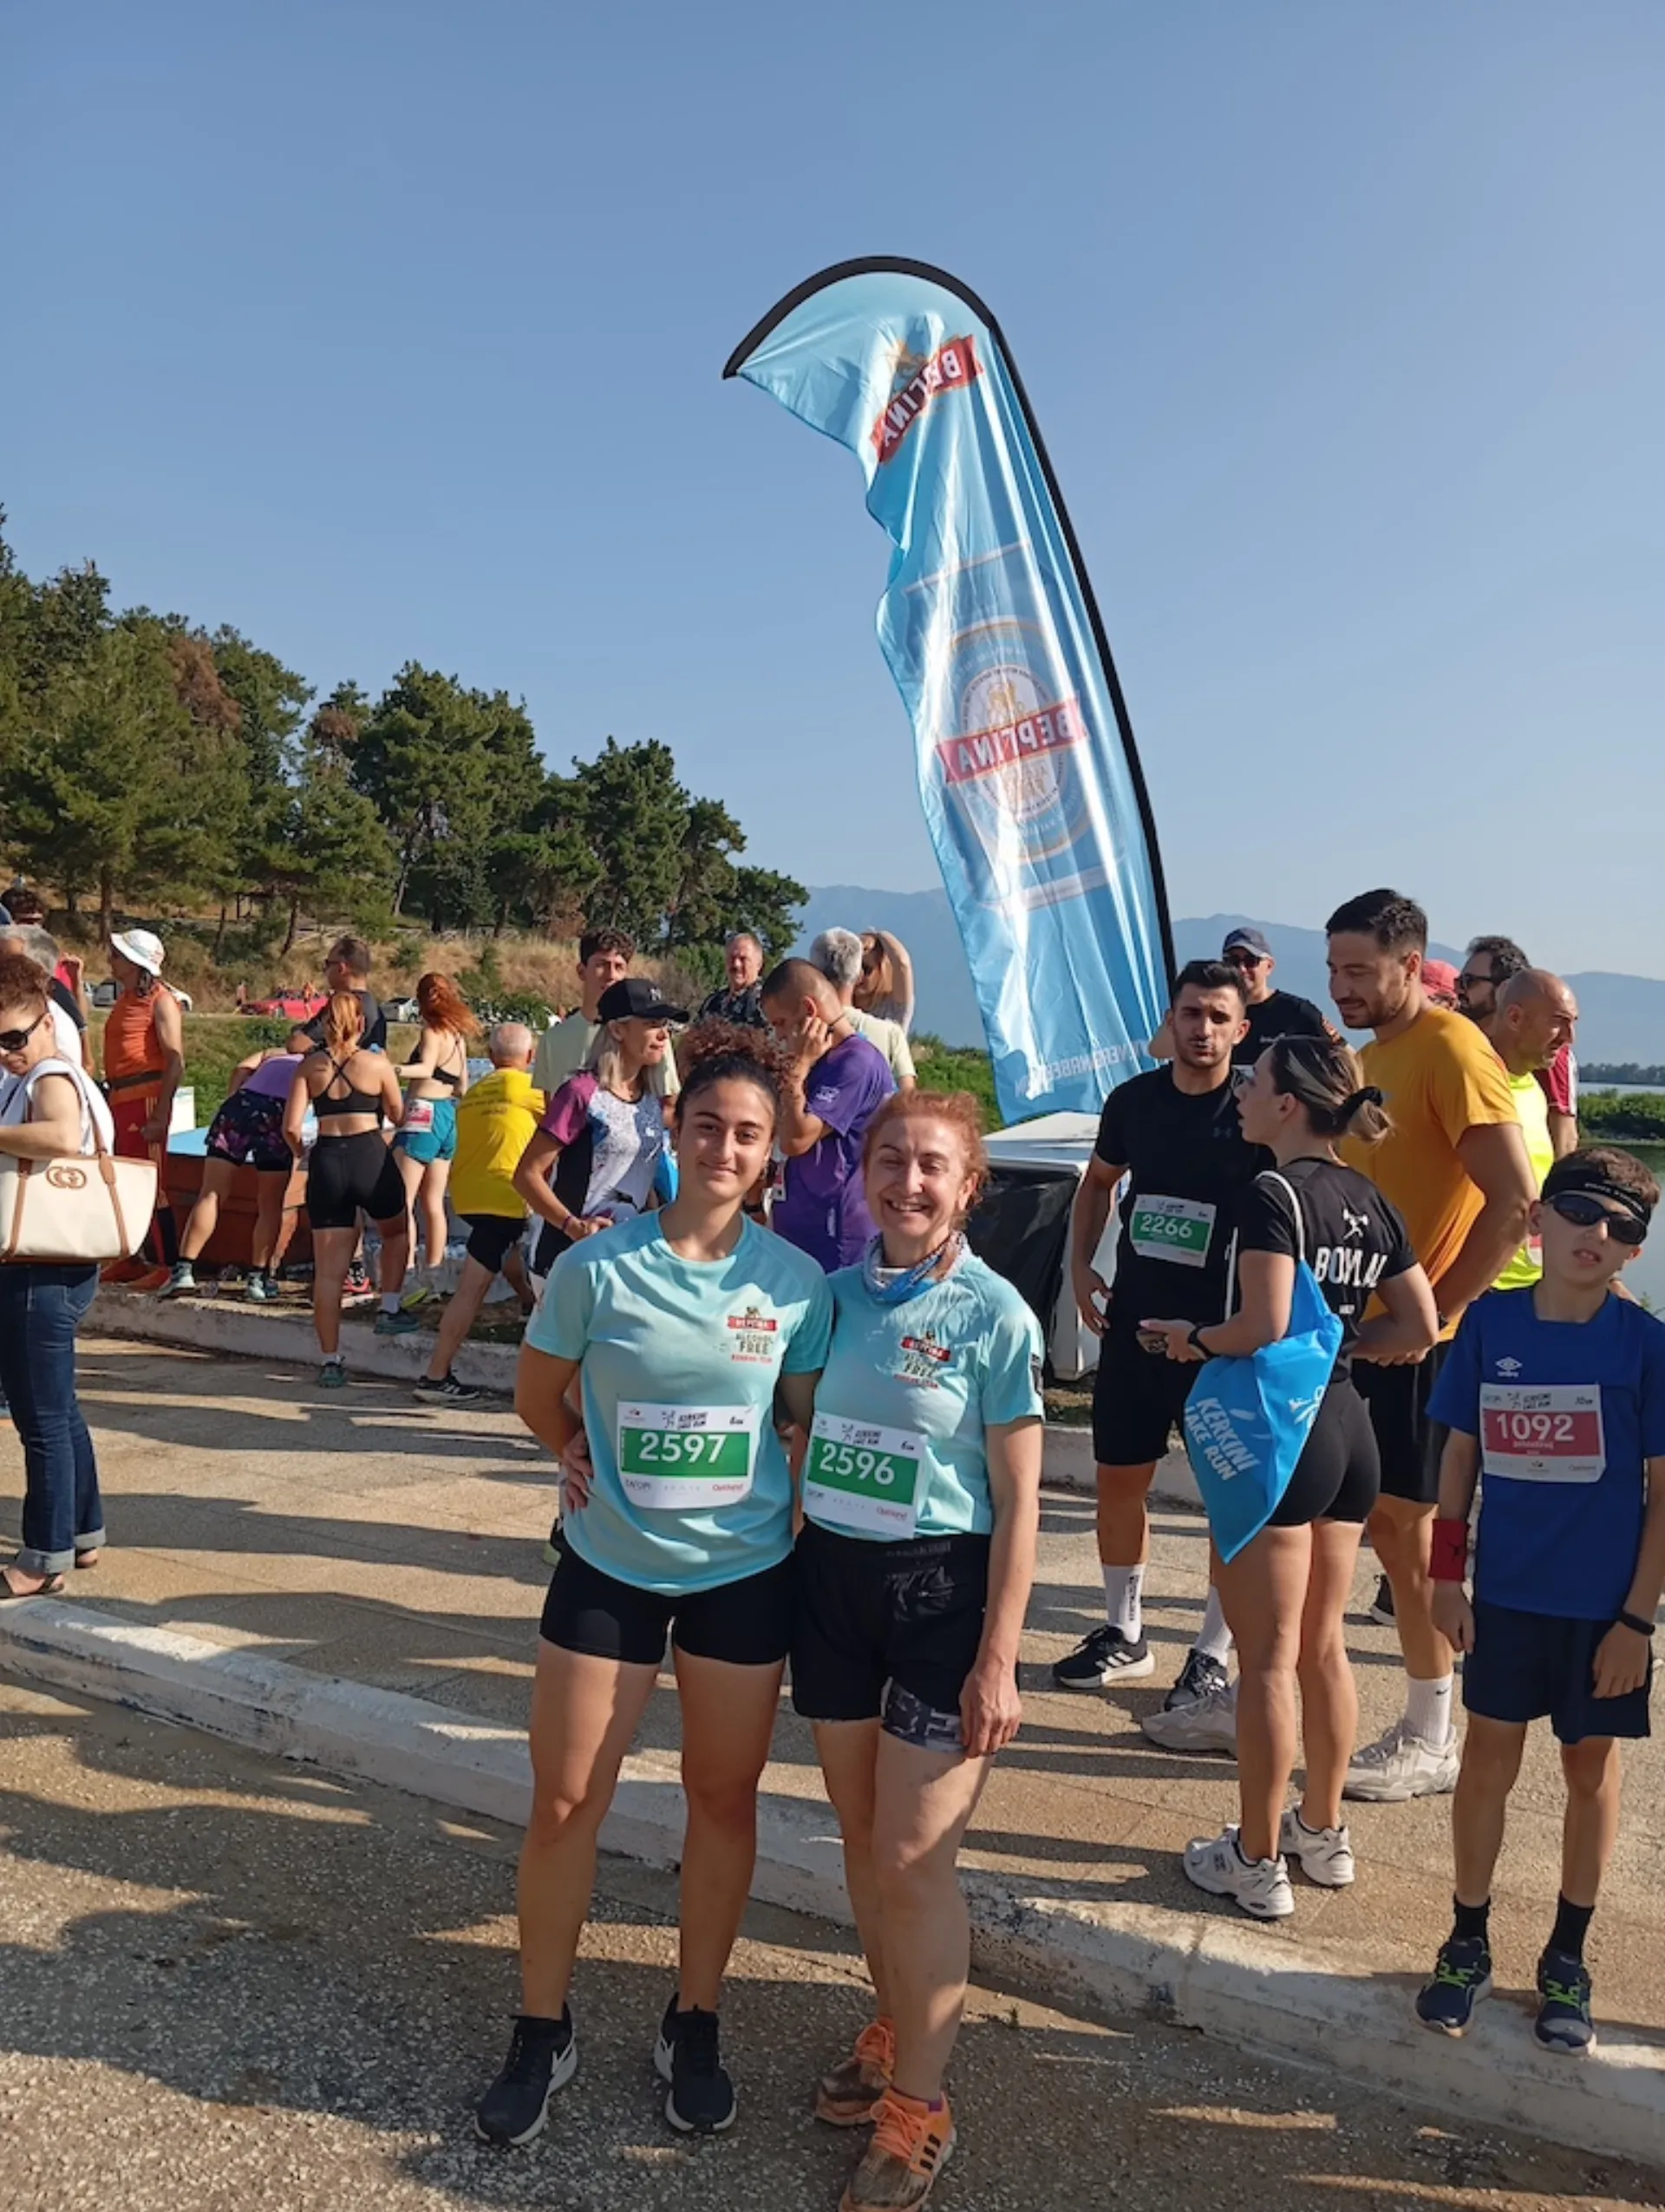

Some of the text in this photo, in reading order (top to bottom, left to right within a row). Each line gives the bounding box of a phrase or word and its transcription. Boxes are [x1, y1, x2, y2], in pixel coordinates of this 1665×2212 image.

[1140, 1214, 1192, 1238] 2266
[740, 1341, 769, 1354] FREE
[1196, 1397, 1261, 1471] KERKINI
[1497, 1413, 1576, 1442] 1092
[639, 1432, 728, 1464] 2597
[819, 1442, 895, 1485] 2596
[1203, 1445, 1238, 1481] RUN
